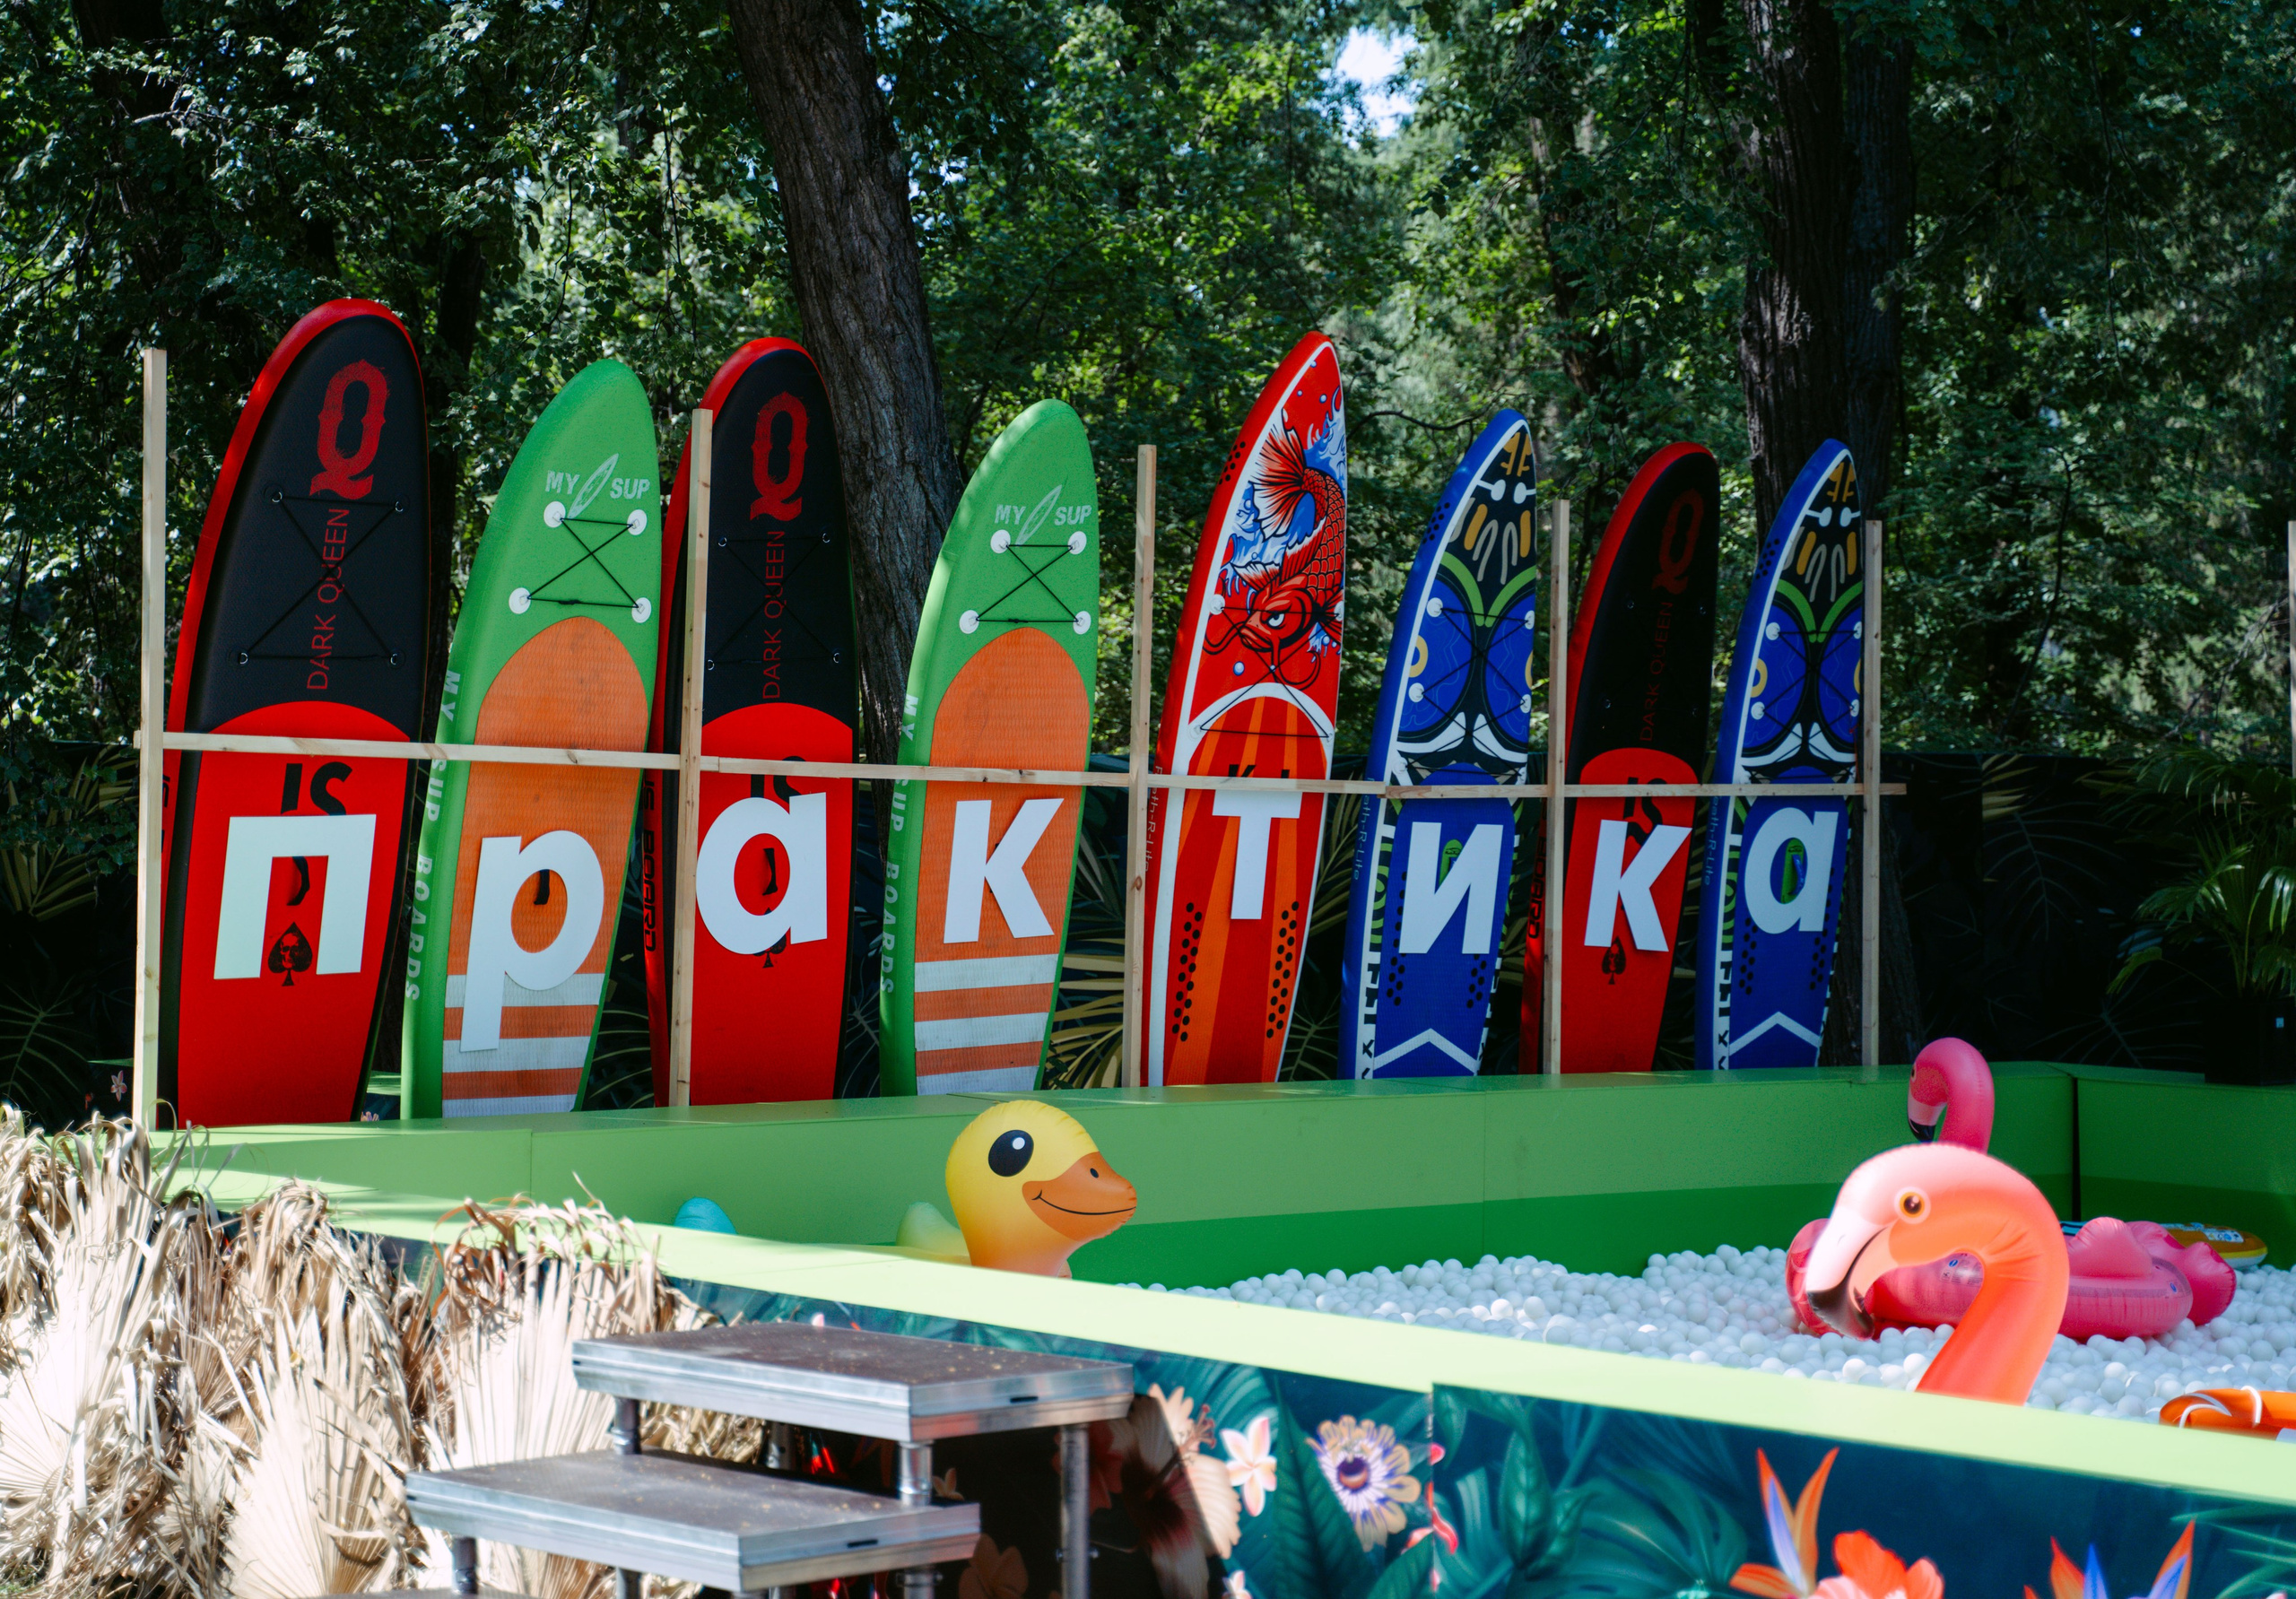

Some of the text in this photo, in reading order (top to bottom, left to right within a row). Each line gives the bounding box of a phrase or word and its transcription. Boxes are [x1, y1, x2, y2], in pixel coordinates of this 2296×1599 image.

[309, 359, 390, 500] Q
[544, 469, 651, 500] MY SUP
[750, 390, 810, 522] Q
[994, 503, 1092, 526] MY SUP
[1651, 488, 1704, 595] Q
[307, 508, 350, 690] DARK QUEEN
[762, 530, 787, 700] DARK QUEEN
[439, 669, 461, 723] MY
[901, 693, 919, 742] MY
[1639, 601, 1674, 743] DARK QUEEN
[405, 853, 433, 1001] BOARDS
[643, 829, 657, 952] BOARD
[880, 860, 900, 994] BOARDS
